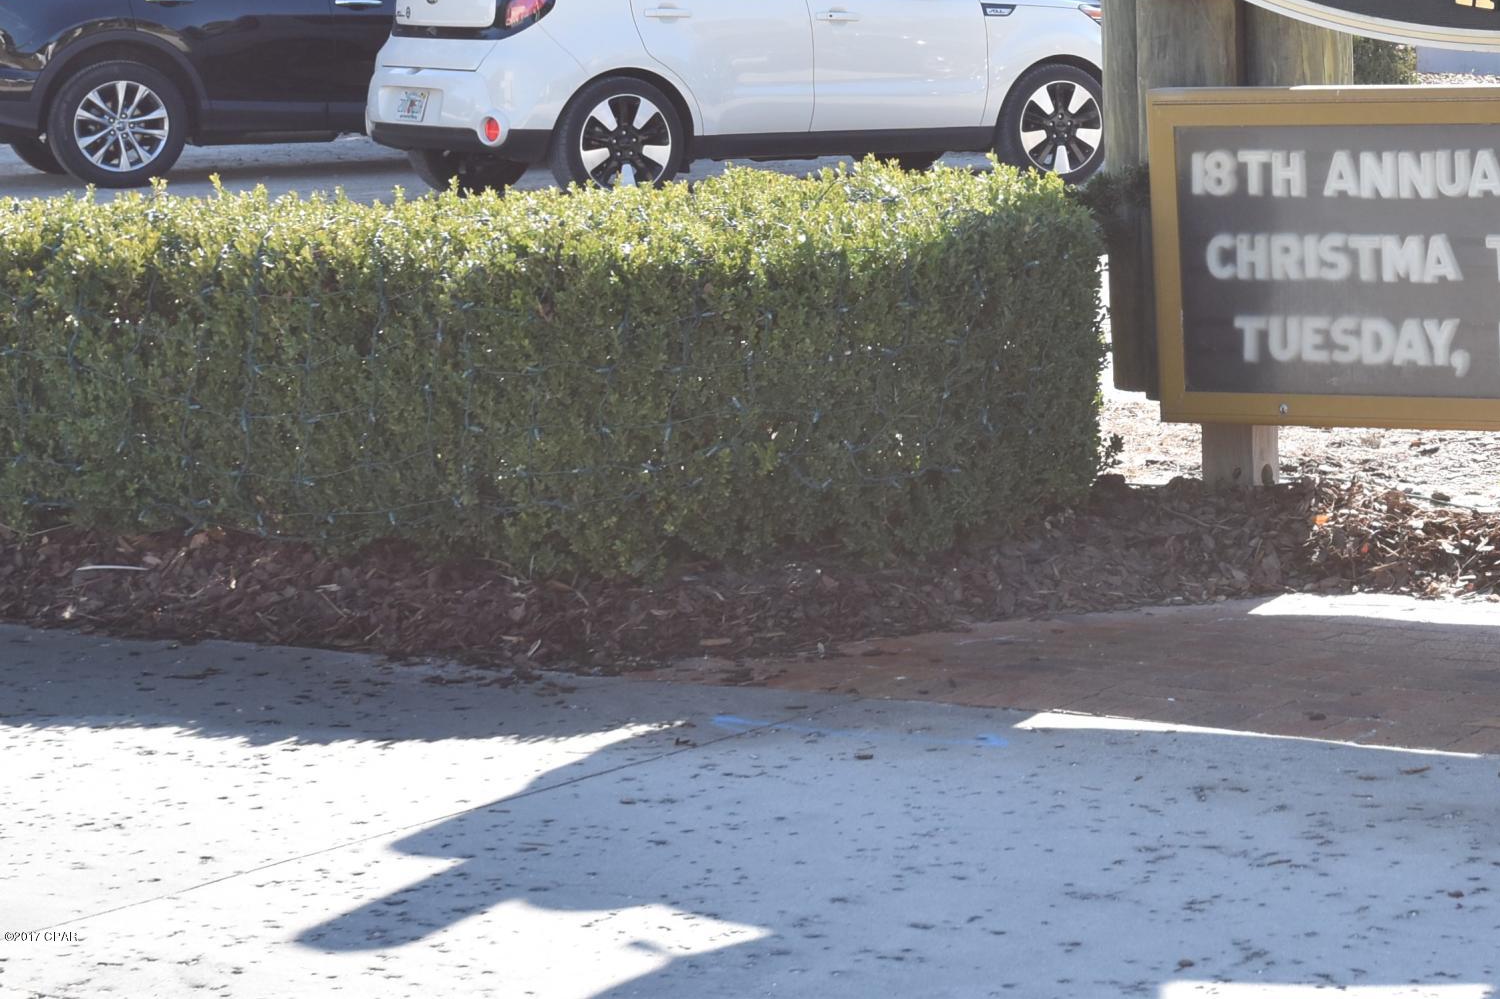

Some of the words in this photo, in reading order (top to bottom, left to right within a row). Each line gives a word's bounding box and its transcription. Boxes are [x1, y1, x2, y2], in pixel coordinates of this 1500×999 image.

[1191, 149, 1308, 197] 18TH
[1205, 232, 1464, 283] CHRISTMA
[1233, 316, 1471, 378] TUESDAY,
